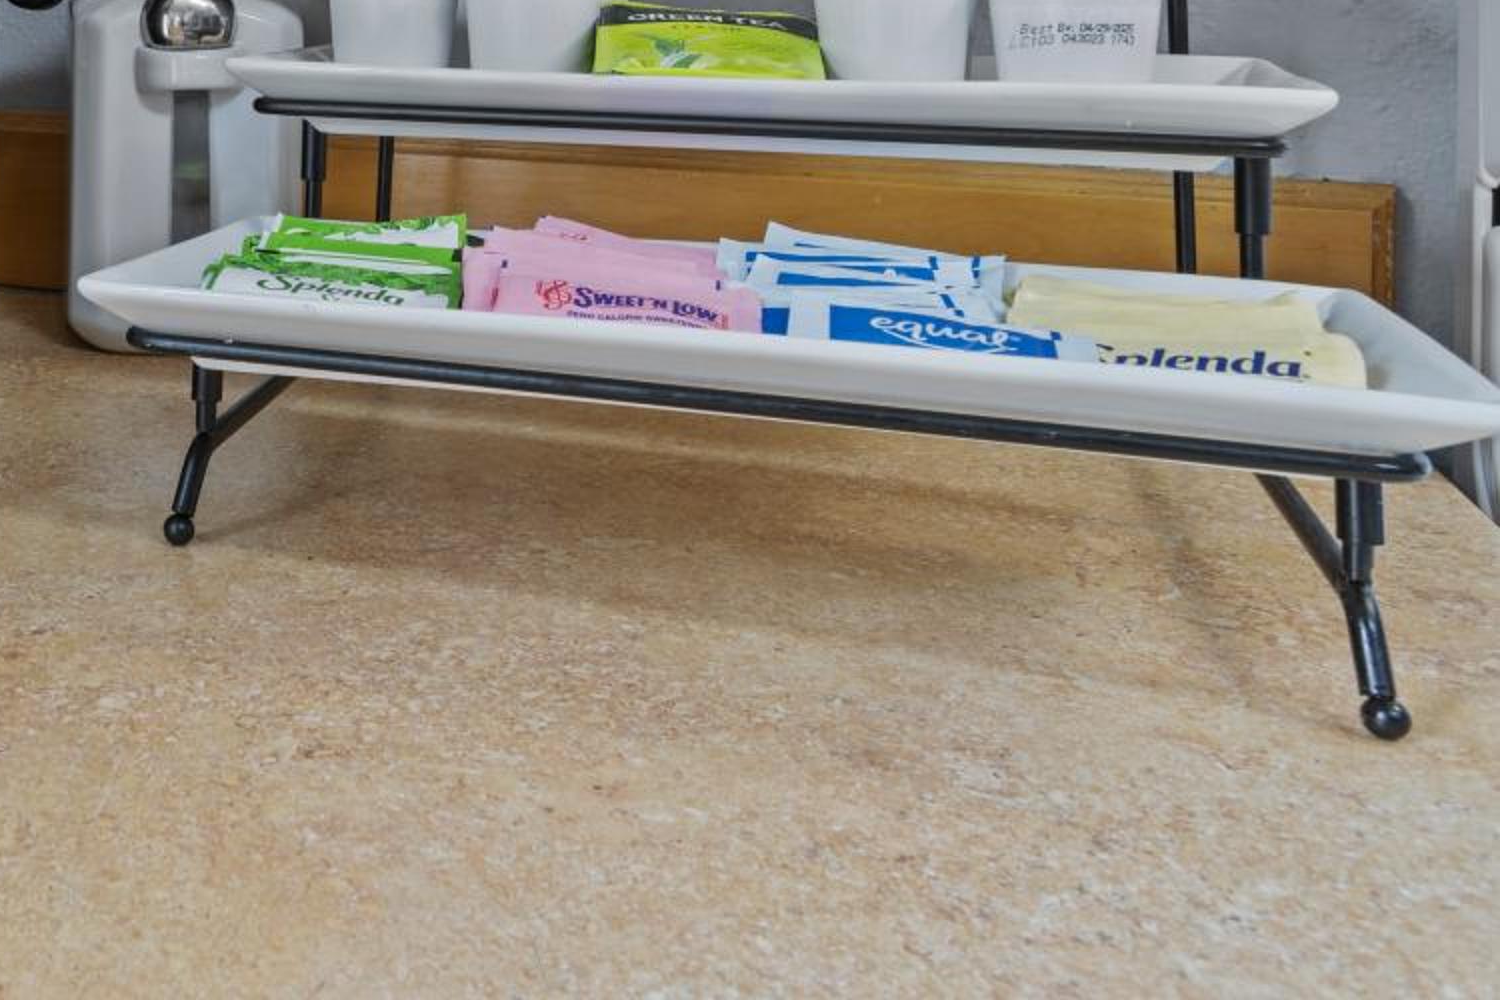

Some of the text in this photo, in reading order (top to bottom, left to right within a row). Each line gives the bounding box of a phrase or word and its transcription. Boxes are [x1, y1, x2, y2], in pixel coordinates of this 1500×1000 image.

[627, 12, 788, 30] GREEN TEA
[256, 274, 405, 306] Splenda
[673, 301, 719, 322] LOW
[870, 315, 1017, 352] equal
